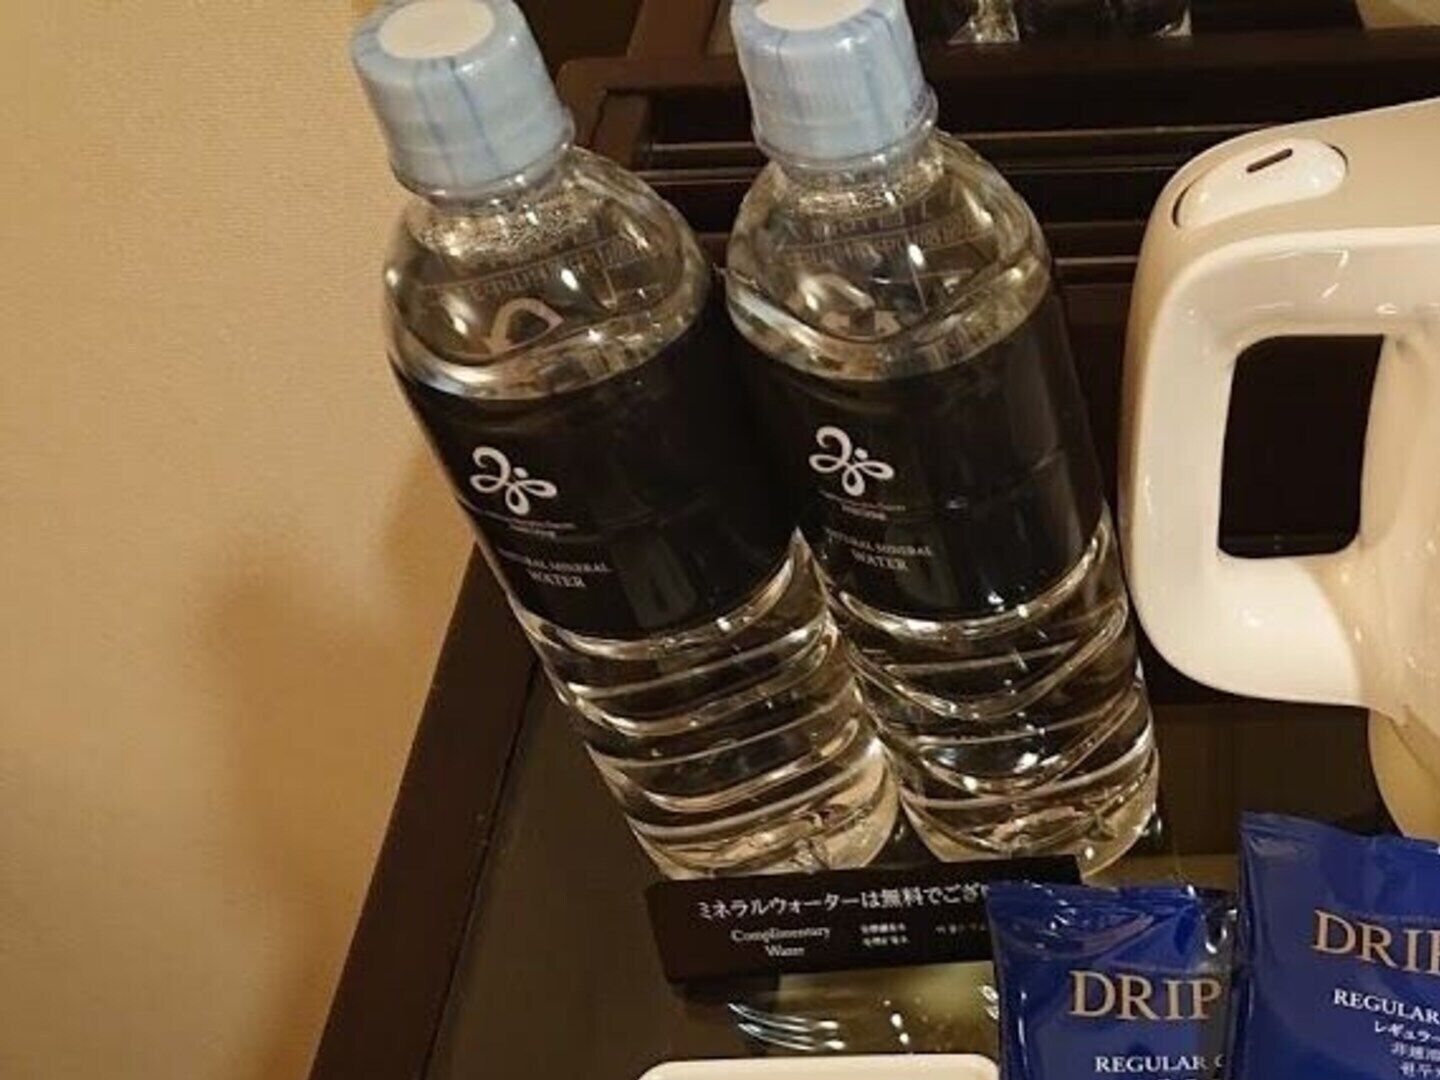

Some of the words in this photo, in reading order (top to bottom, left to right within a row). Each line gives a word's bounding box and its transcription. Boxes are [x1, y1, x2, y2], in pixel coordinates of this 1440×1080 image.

[730, 926, 831, 943] Complimentary
[1068, 969, 1223, 1021] DRIP
[1333, 987, 1440, 1026] REGULAR
[1094, 1054, 1209, 1073] REGULAR
